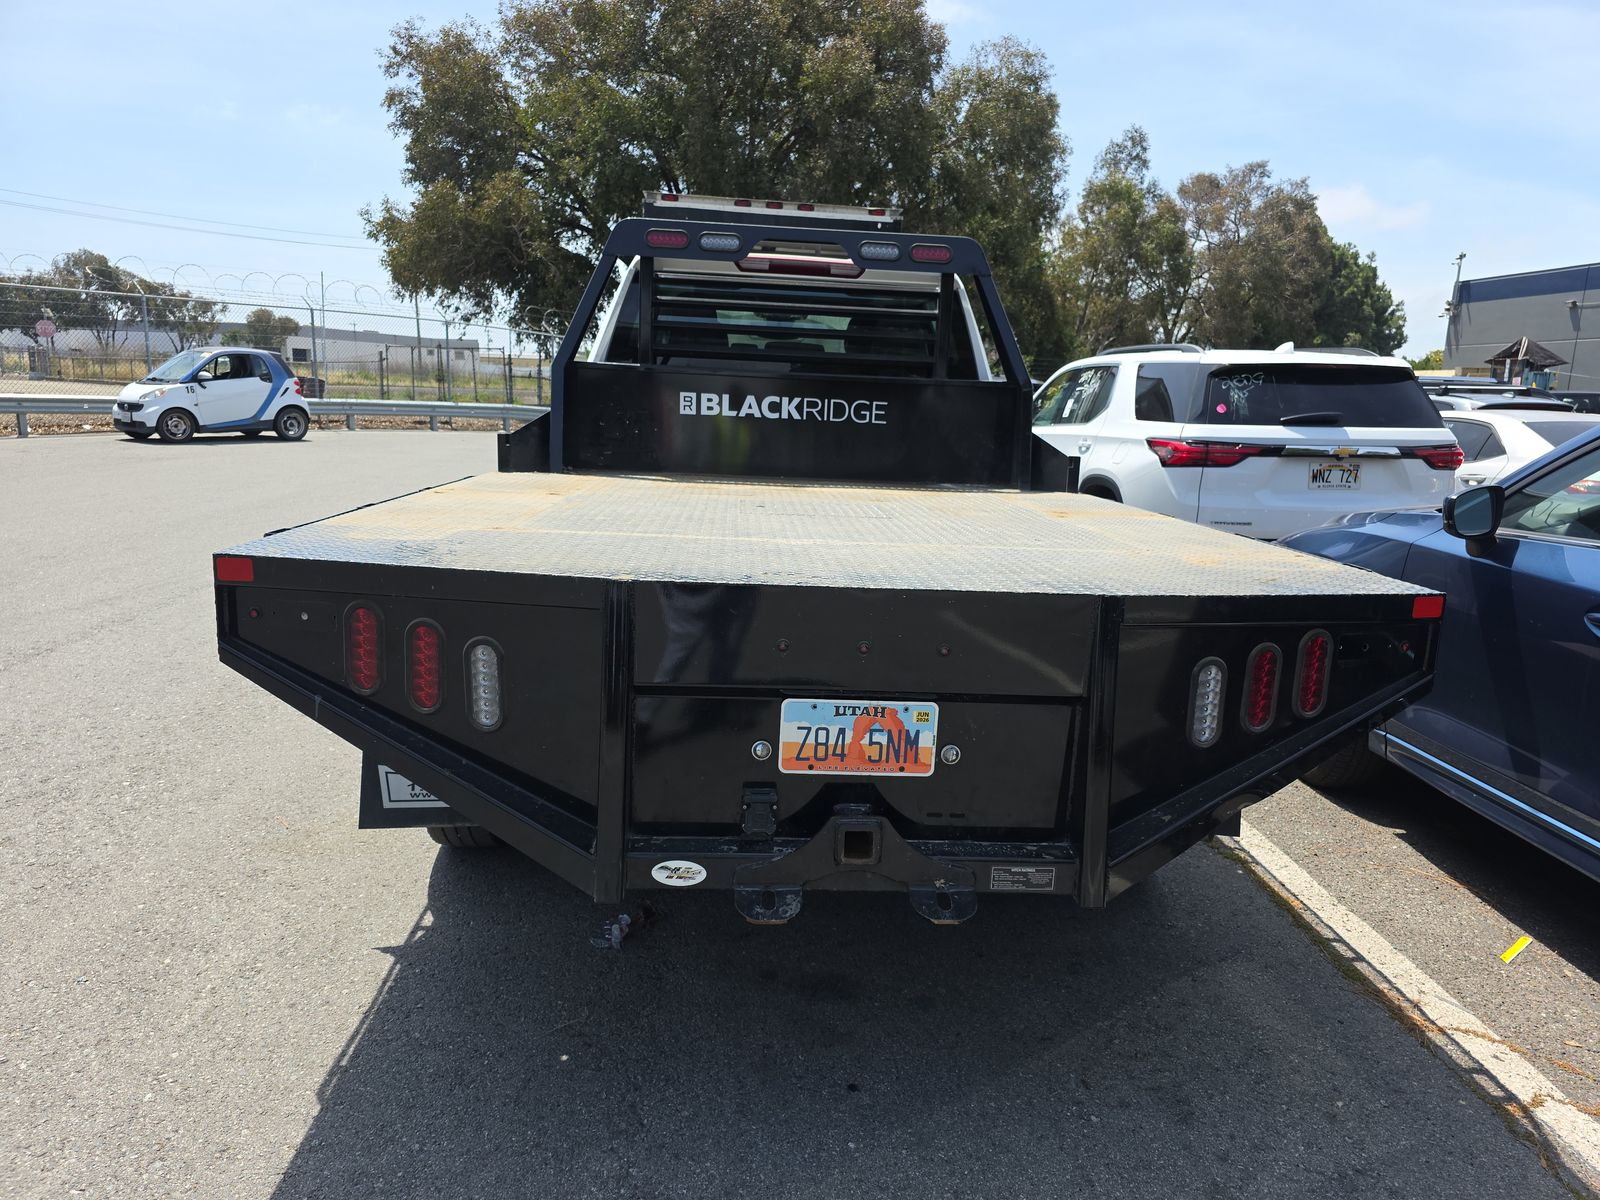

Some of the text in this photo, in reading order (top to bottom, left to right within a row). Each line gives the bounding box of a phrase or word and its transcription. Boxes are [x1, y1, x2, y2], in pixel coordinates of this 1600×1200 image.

[185, 386, 195, 394] 16
[700, 392, 889, 424] BLACKRIDGE
[1311, 469, 1359, 483] WNZ 727
[833, 705, 887, 718] UTAH
[795, 726, 921, 764] Z84 5NM
